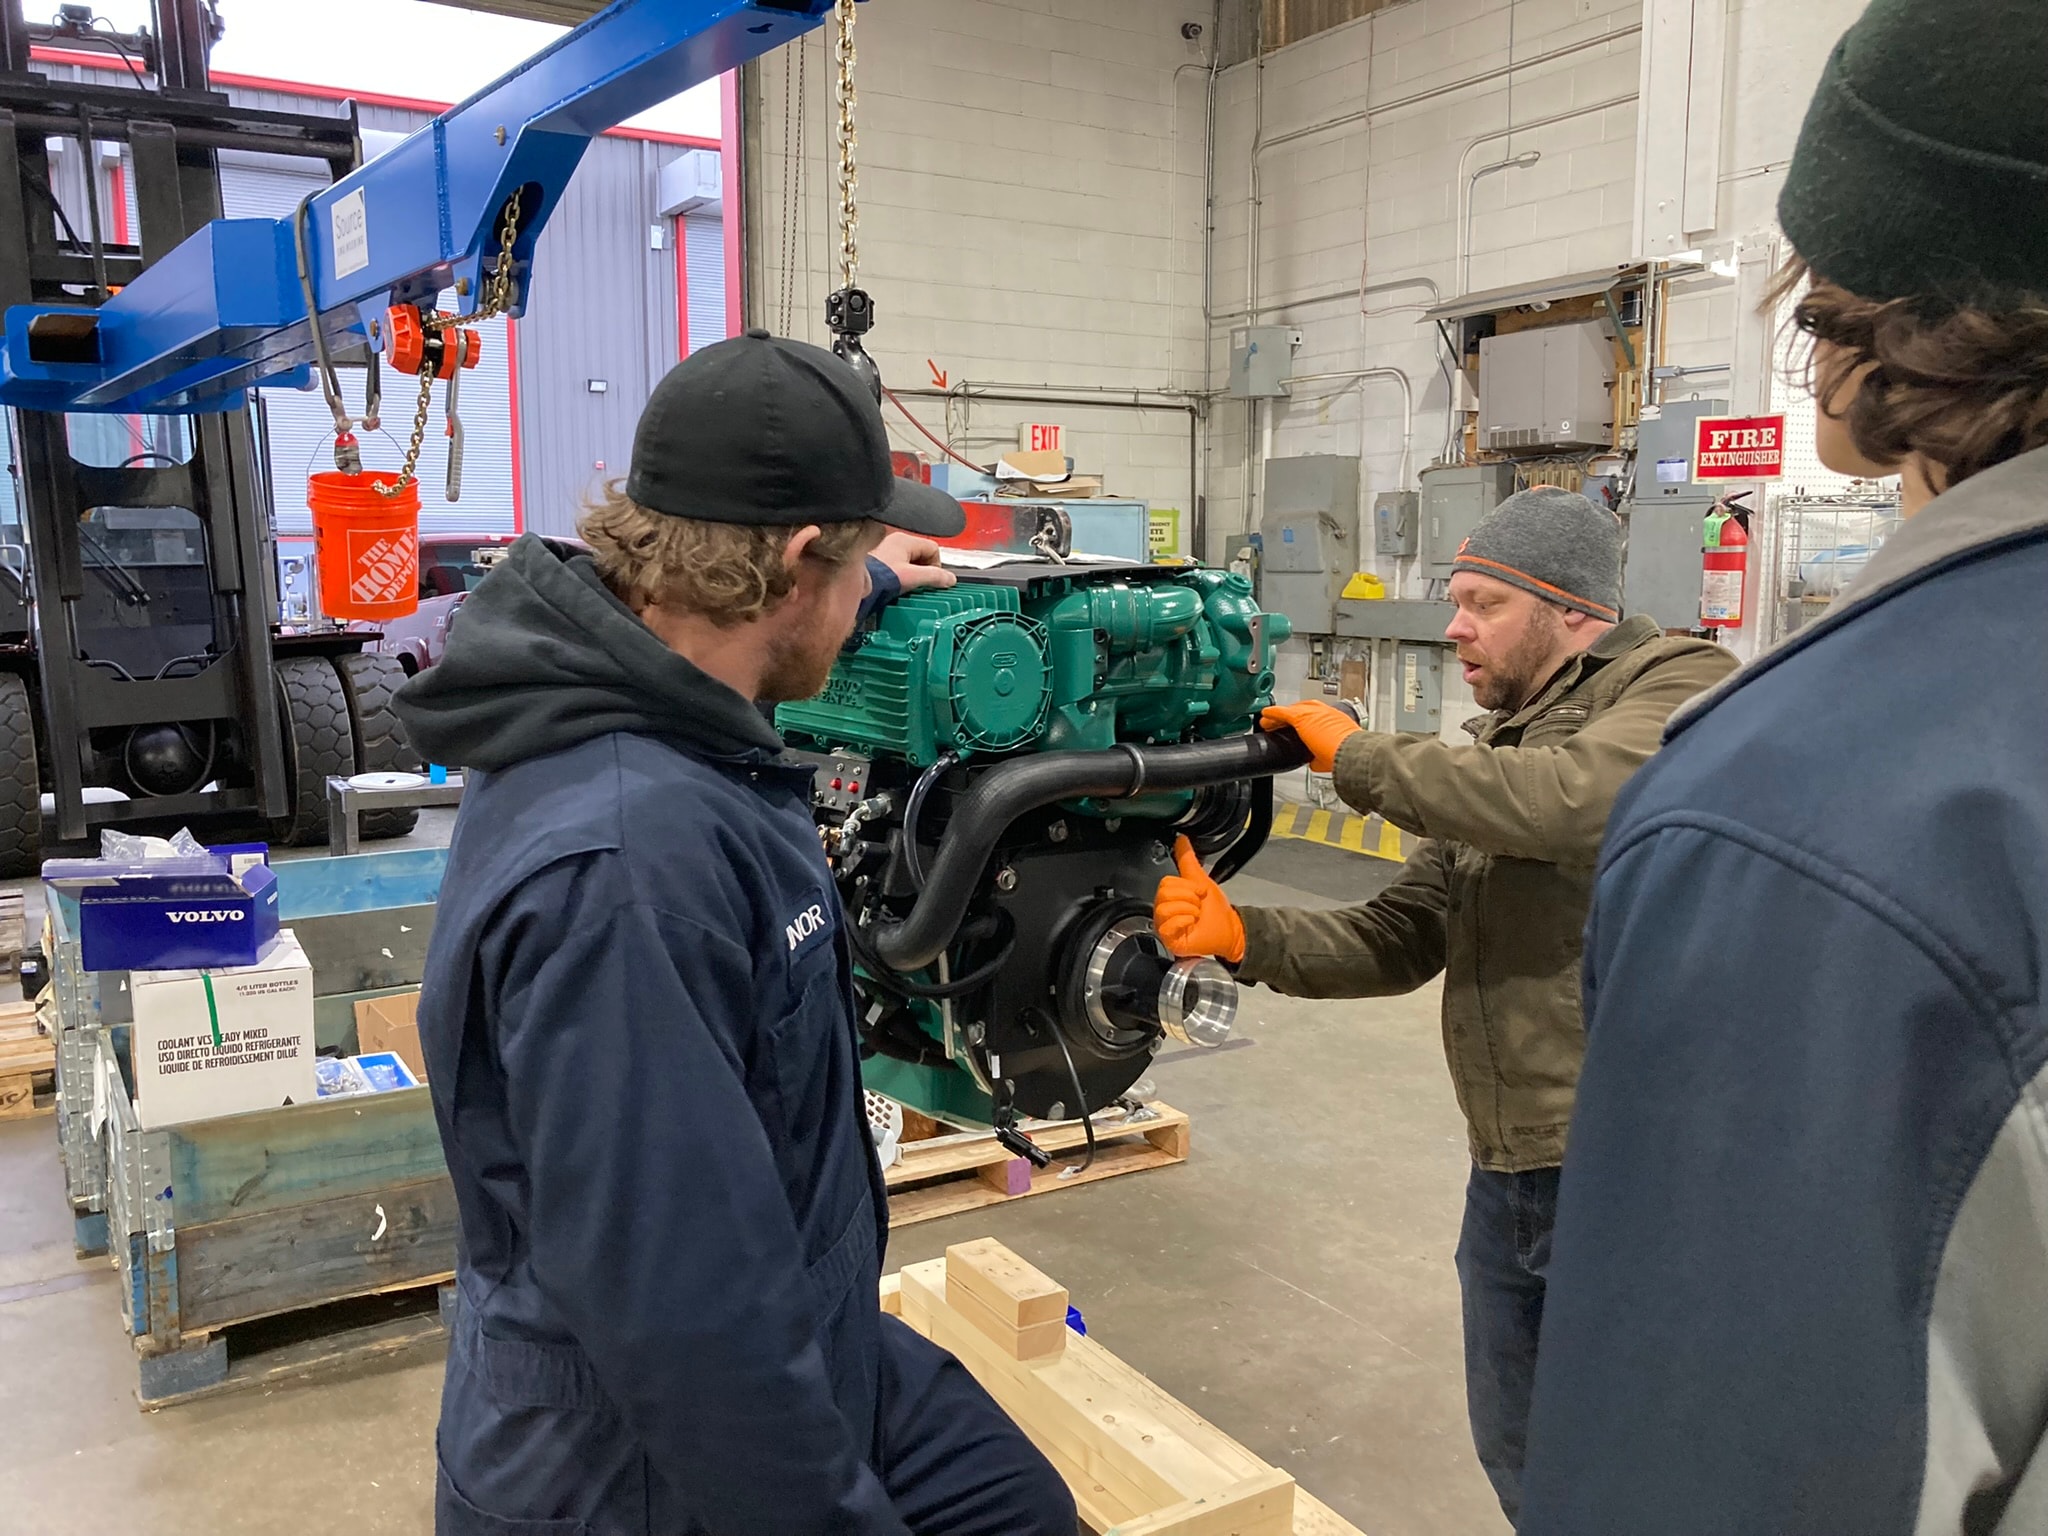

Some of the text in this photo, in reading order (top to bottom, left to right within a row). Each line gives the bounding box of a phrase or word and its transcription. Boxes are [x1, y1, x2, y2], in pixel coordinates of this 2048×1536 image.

[1031, 425, 1060, 451] EXIT
[1709, 427, 1776, 449] FIRE
[1699, 449, 1780, 467] EXTINGUISHER
[357, 538, 391, 568] THE
[352, 528, 416, 602] HOME
[824, 678, 862, 694] OLVO
[166, 910, 245, 923] VOLVO
[269, 979, 299, 988] BOTTLES
[157, 1028, 268, 1050] COOLANT VCS EADY MIXED
[158, 1035, 301, 1062] USO DIRECTO LIQUIDO REFRIGERANTE
[159, 1047, 298, 1075] LIQUIDE DE REFROIDISSEMENT DILUÉ
